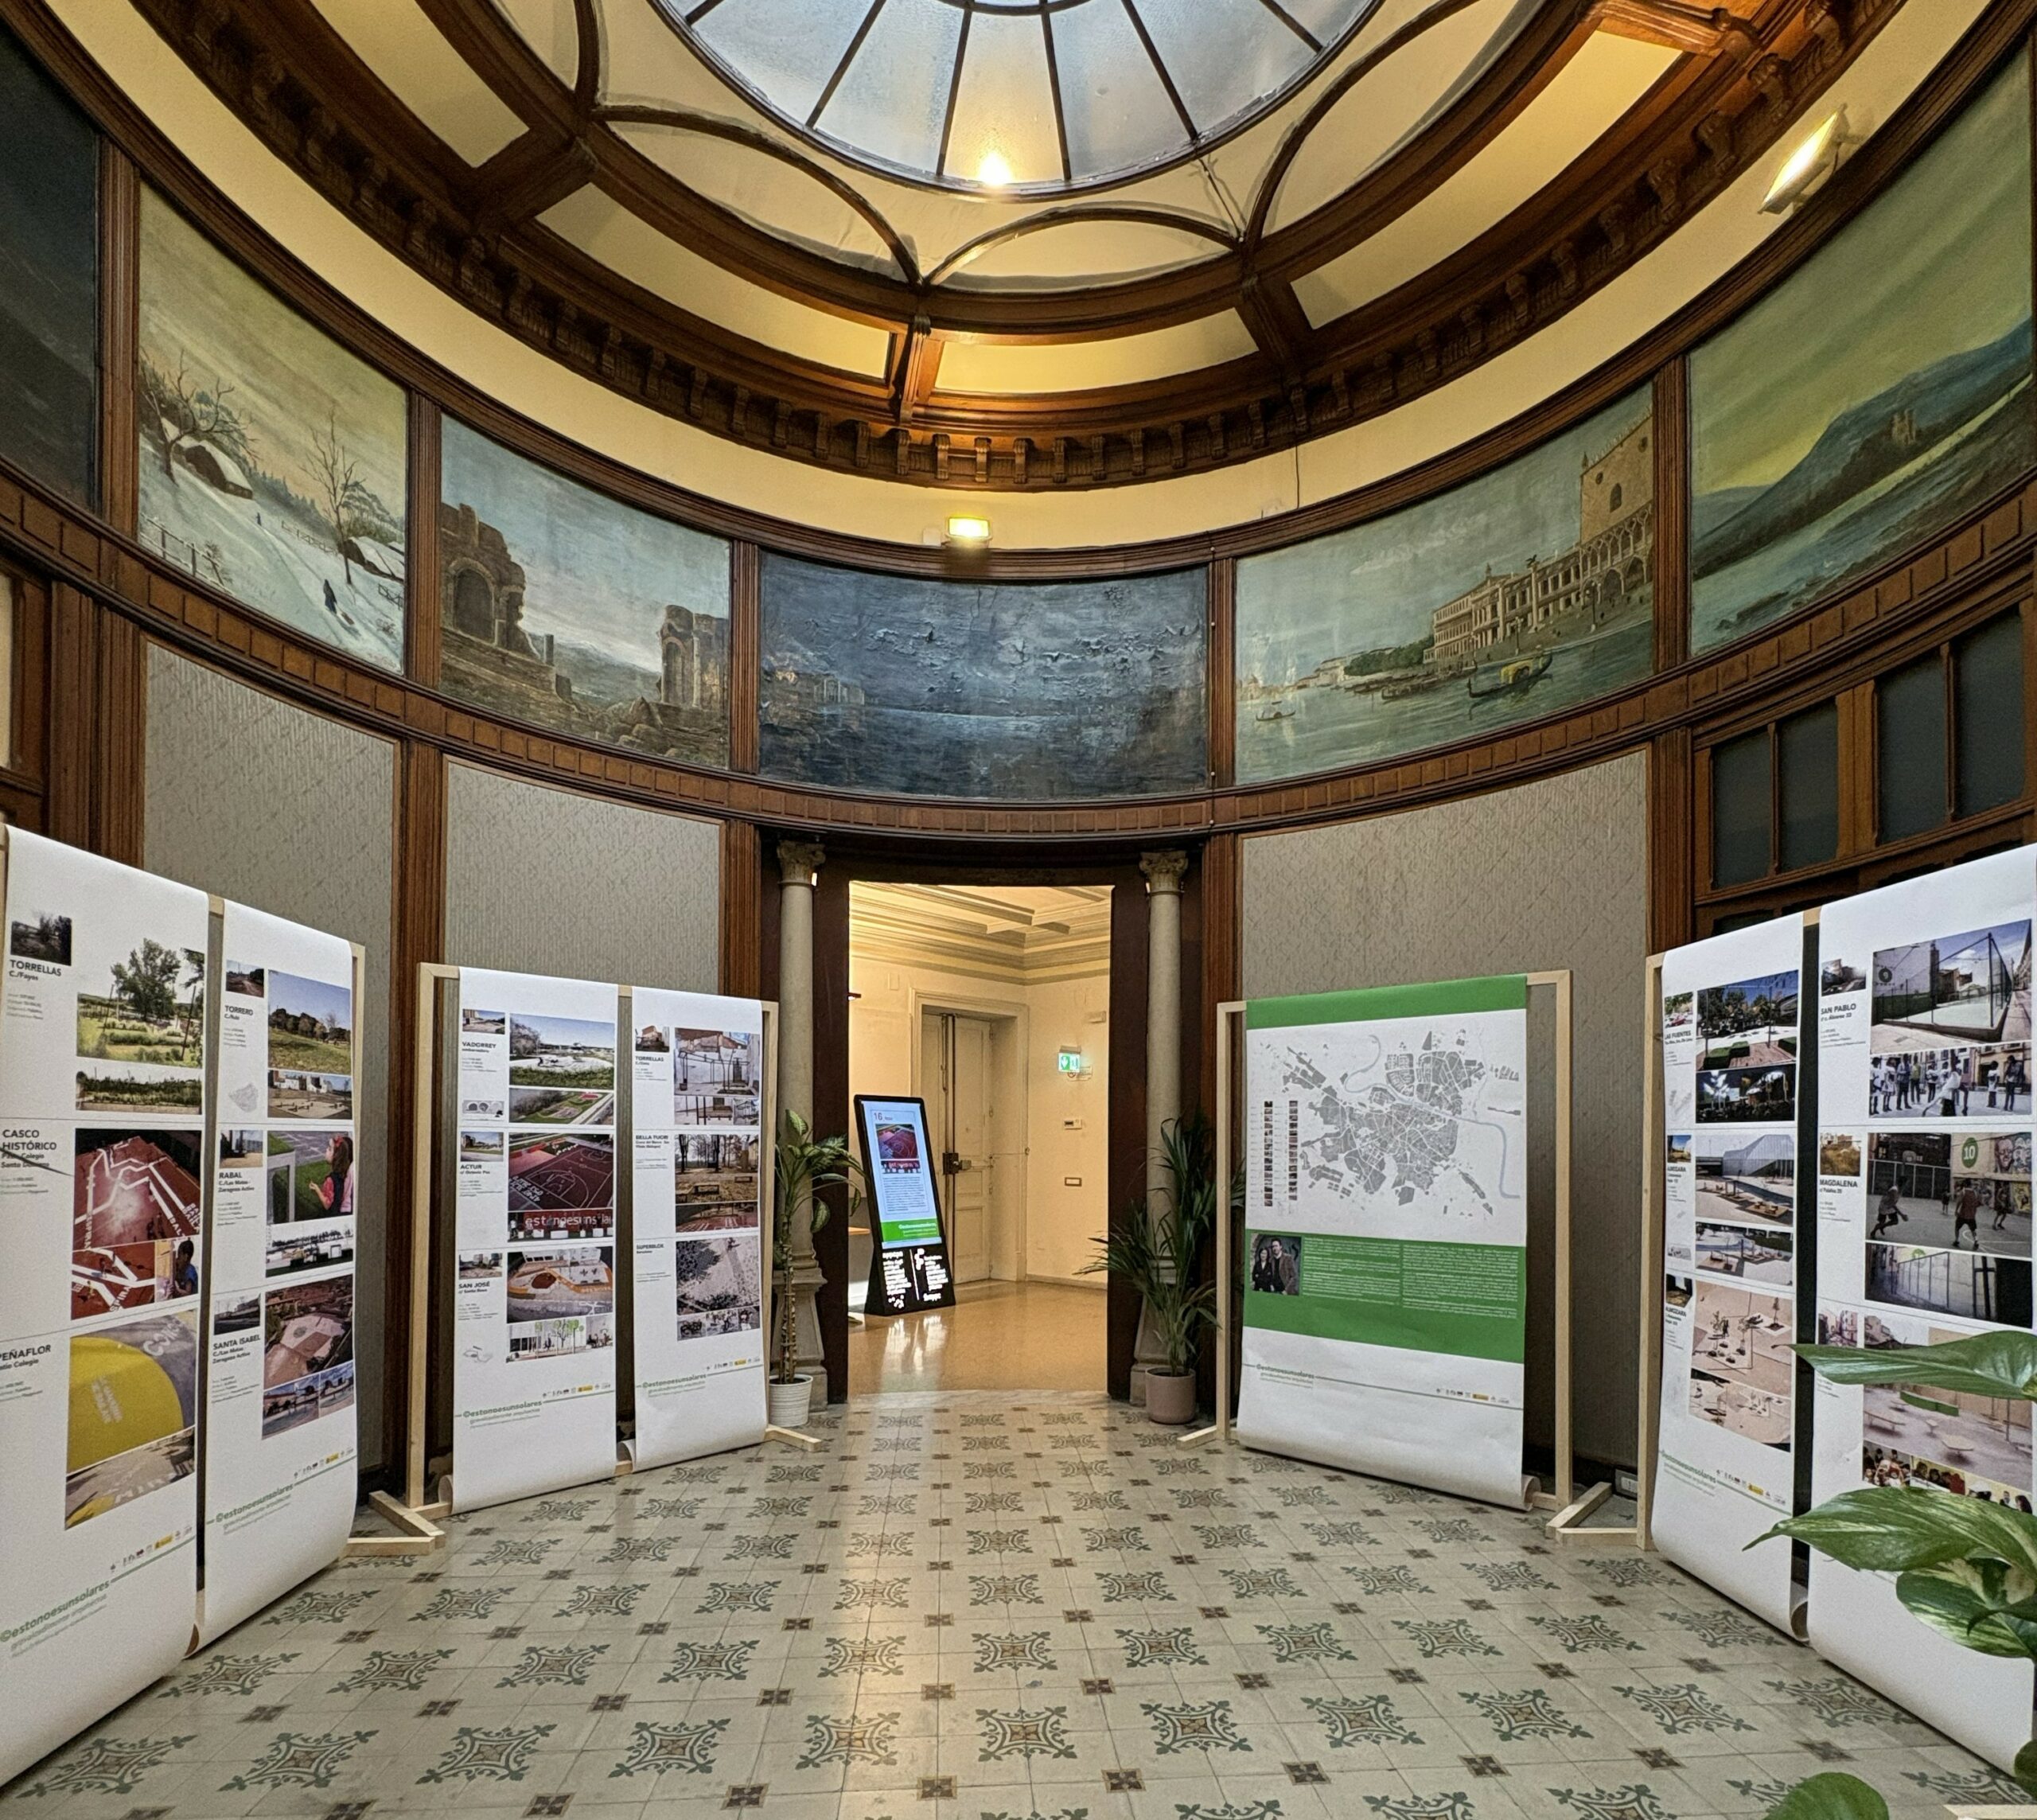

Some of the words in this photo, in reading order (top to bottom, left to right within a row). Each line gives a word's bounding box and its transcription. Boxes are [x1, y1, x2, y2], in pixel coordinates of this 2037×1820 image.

[10, 959, 62, 976] TORRELLAS
[224, 1005, 254, 1016] TORRERO
[1834, 1003, 1856, 1013] PABLO
[2, 1128, 40, 1139] CASCO
[2, 1140, 57, 1151] HISTÓRICO
[1963, 1145, 1975, 1160] 10
[213, 1339, 238, 1350] SANTA
[240, 1334, 261, 1345] ISABEL
